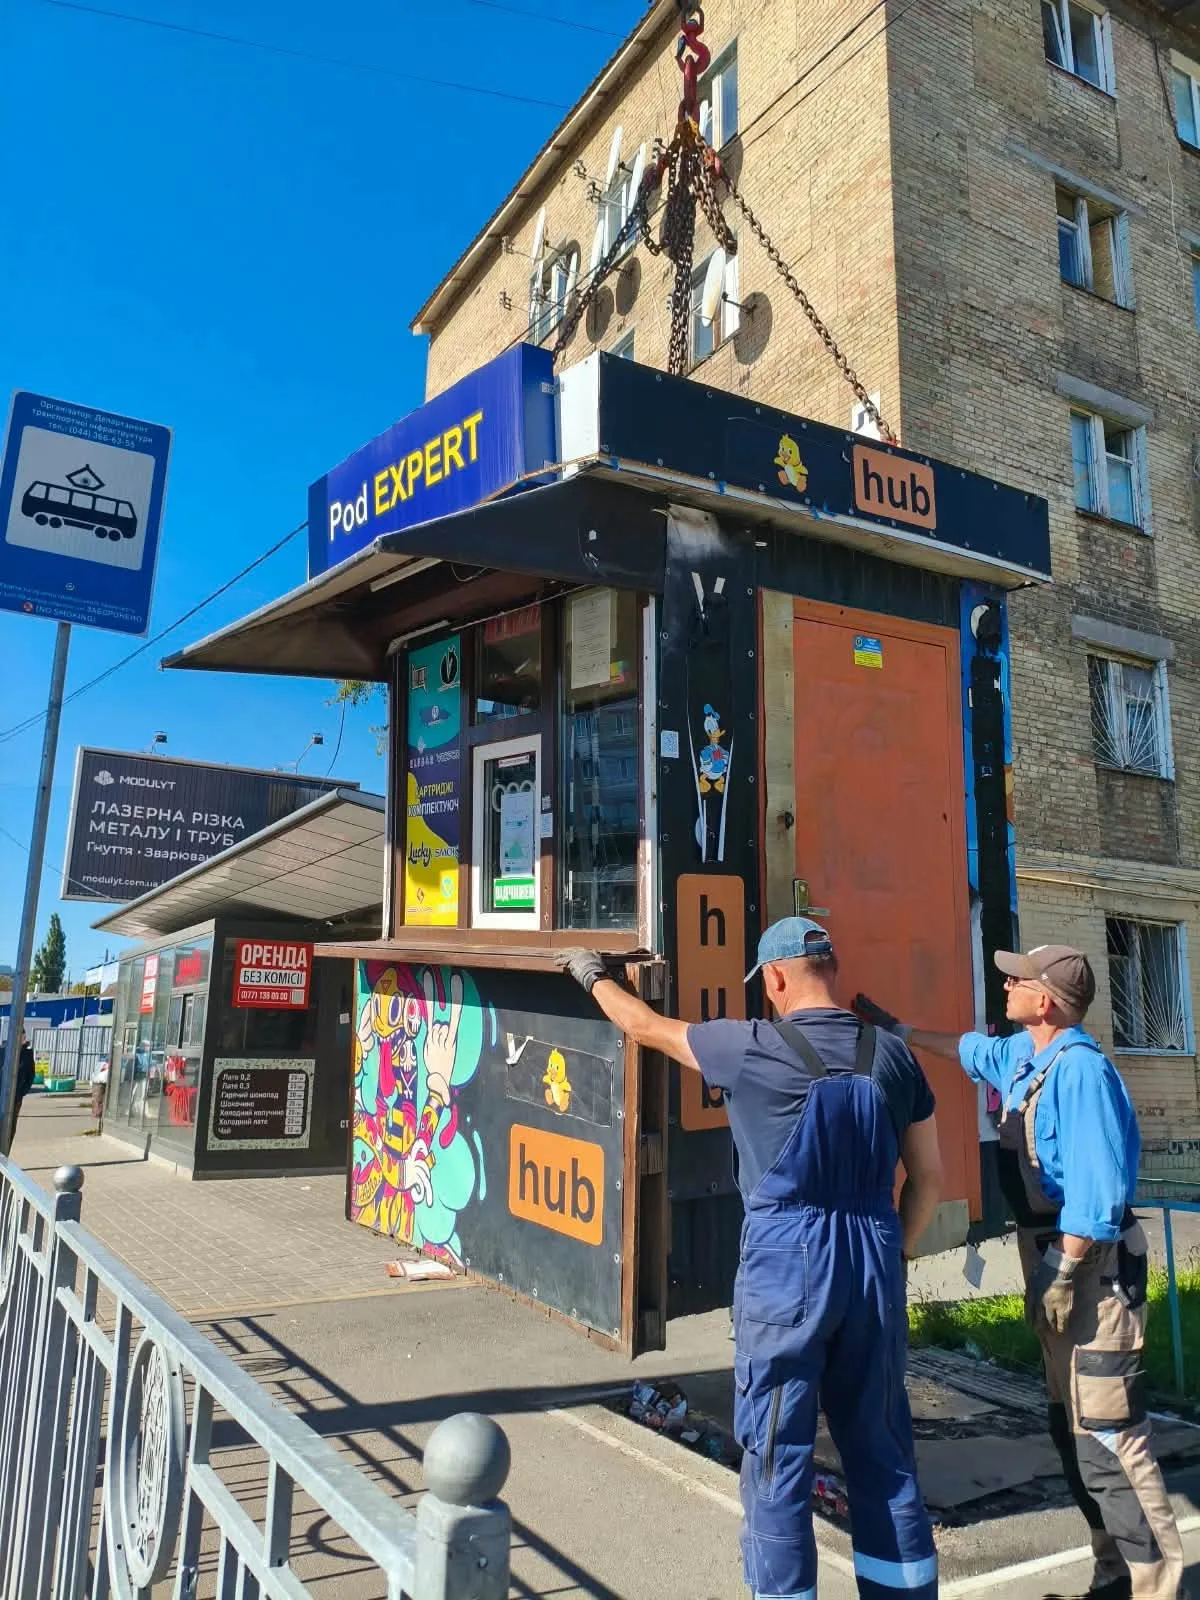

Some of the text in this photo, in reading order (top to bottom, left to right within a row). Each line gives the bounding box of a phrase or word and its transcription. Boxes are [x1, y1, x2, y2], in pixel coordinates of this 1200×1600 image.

[329, 410, 484, 542] Pod EXPERT
[862, 458, 931, 516] hub
[119, 775, 176, 791] MODULYT
[91, 801, 245, 829] ЛАЗЕРНА РІЗКА
[89, 820, 234, 847] МЕТАЛУ І ТРУБ
[87, 841, 132, 857] Гнуття
[408, 841, 431, 867] Lucky
[82, 874, 158, 888] modulyt.com.ua
[241, 943, 307, 969] ОРЕНДА
[243, 970, 261, 983] БЕЗ
[519, 1142, 595, 1223] hub
